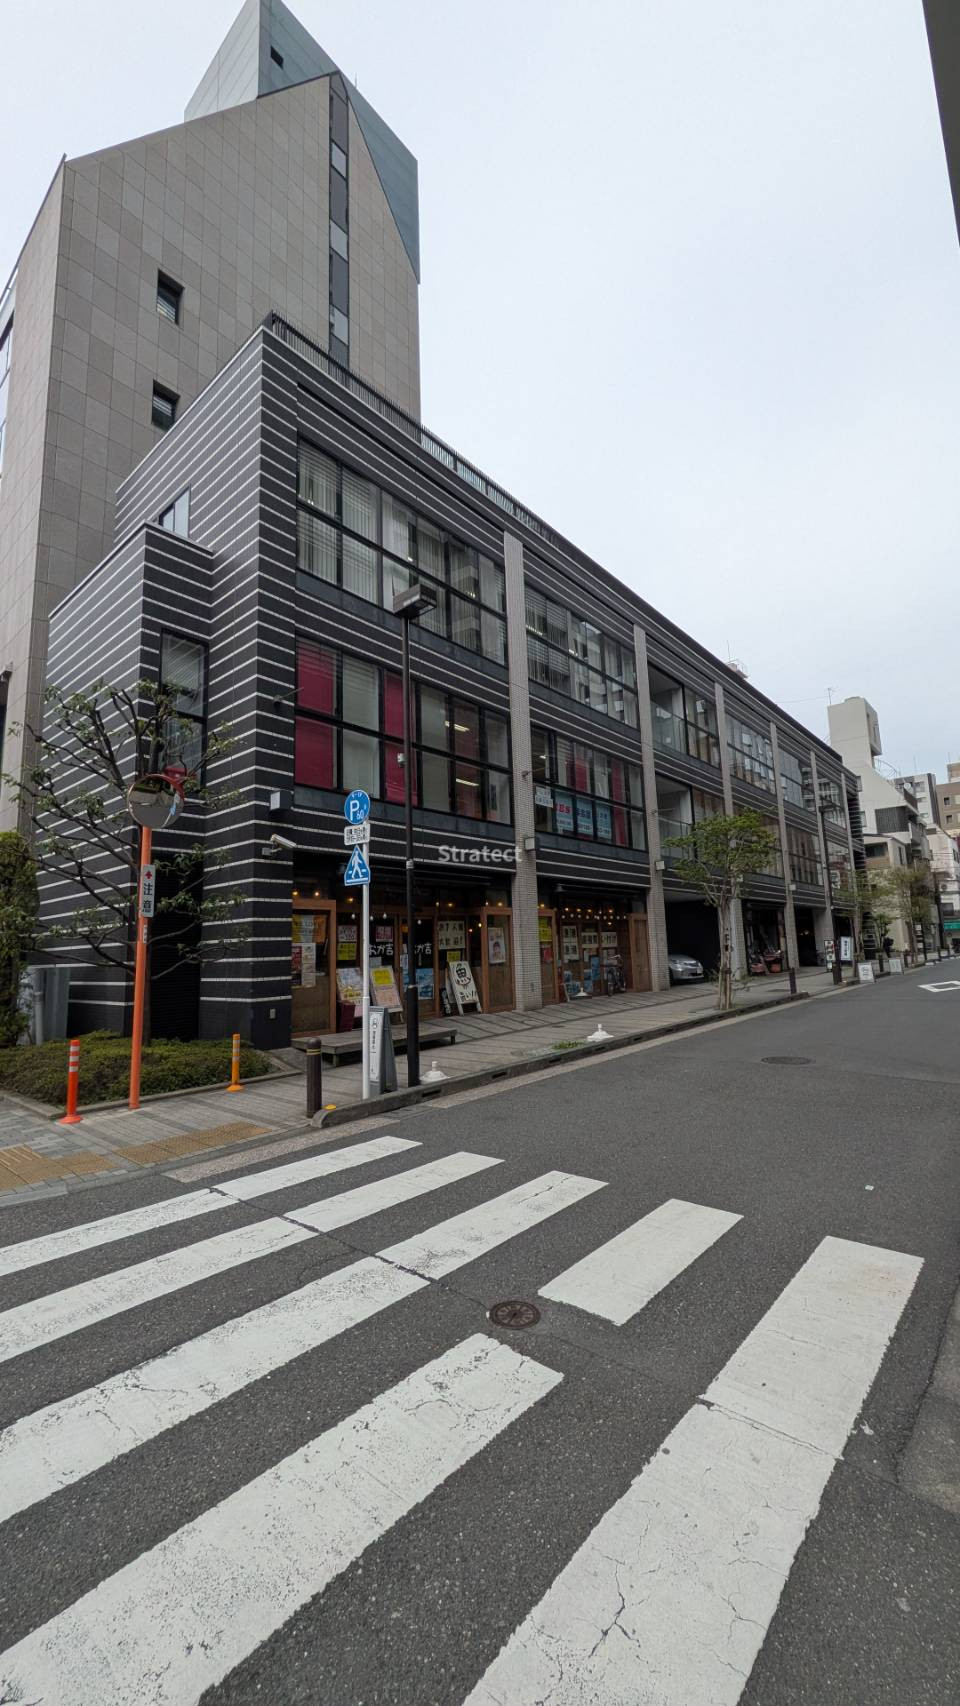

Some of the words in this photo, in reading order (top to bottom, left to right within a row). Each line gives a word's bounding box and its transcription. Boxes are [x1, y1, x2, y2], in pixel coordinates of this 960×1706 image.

[350, 800, 360, 821] P
[438, 845, 523, 862] Stratect
[142, 882, 153, 913] 注意
